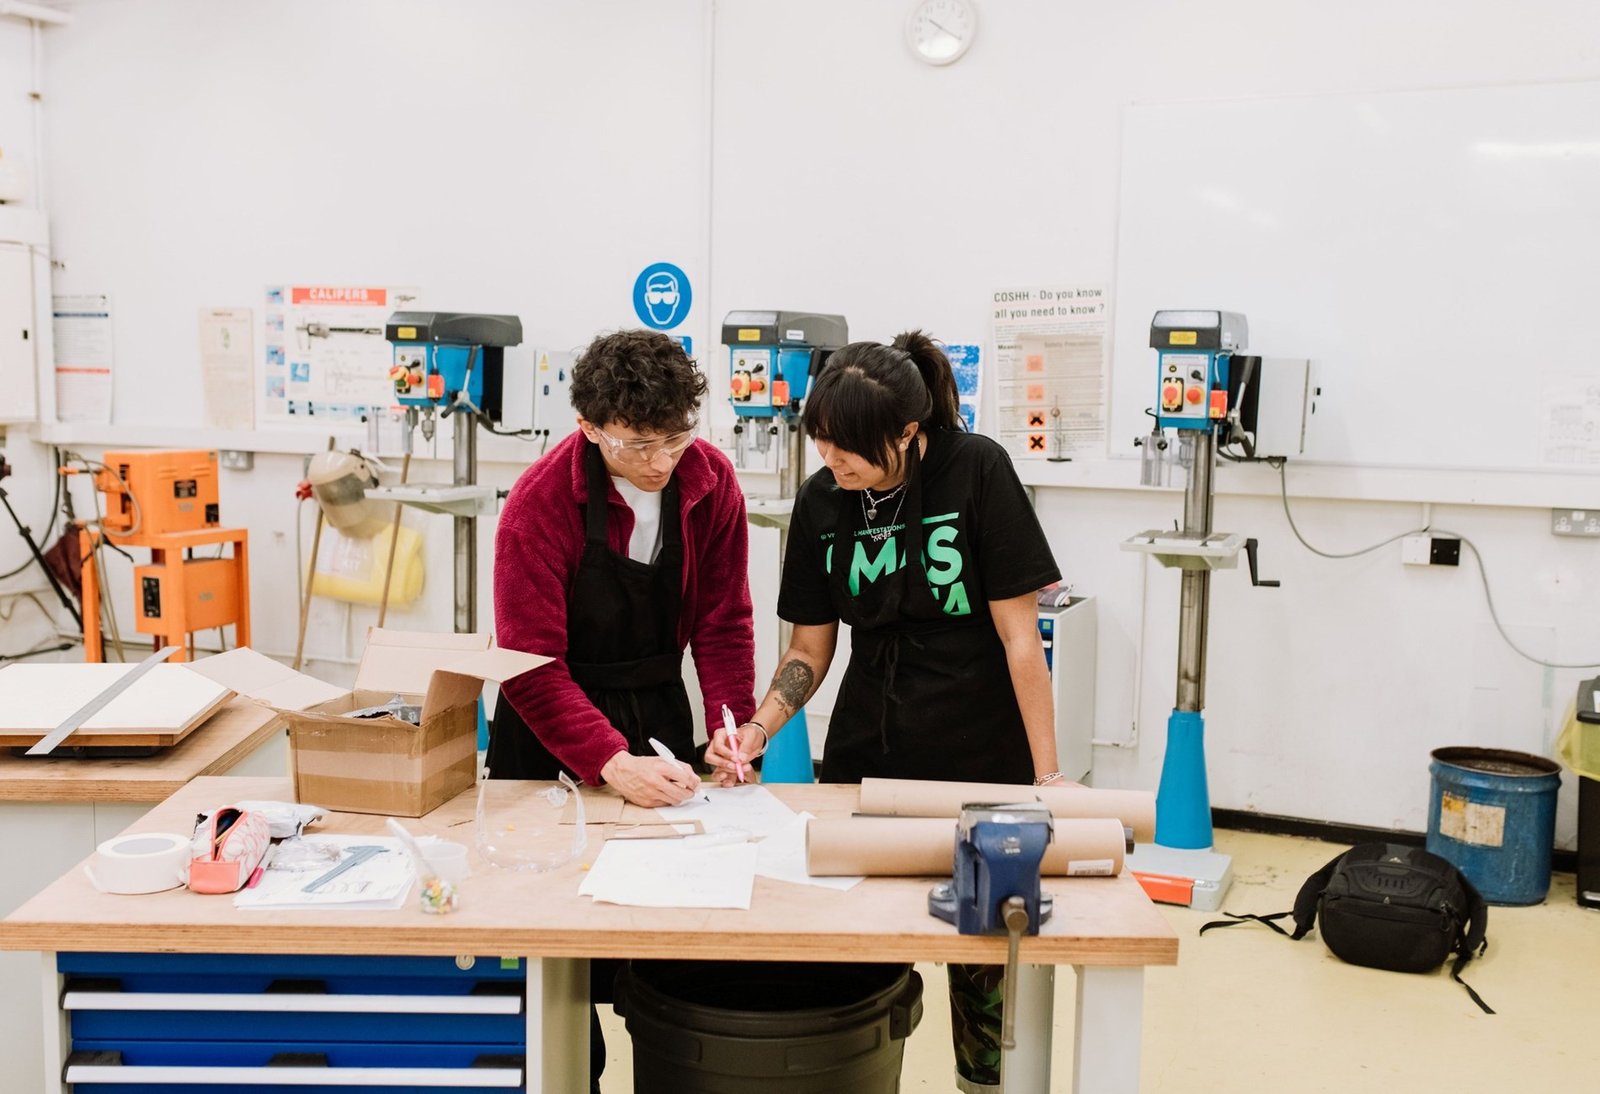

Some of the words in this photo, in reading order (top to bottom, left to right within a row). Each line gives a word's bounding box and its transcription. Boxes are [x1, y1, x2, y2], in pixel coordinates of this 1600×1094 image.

[309, 288, 368, 300] CALIPERS
[993, 291, 1030, 302] COSHH
[1039, 289, 1053, 300] Do
[1056, 291, 1074, 301] you
[1076, 288, 1102, 298] know
[994, 309, 1007, 319] all
[1010, 310, 1028, 320] you
[1031, 306, 1055, 317] need
[1057, 306, 1067, 316] to
[1070, 304, 1096, 315] know
[1099, 303, 1105, 313] ?
